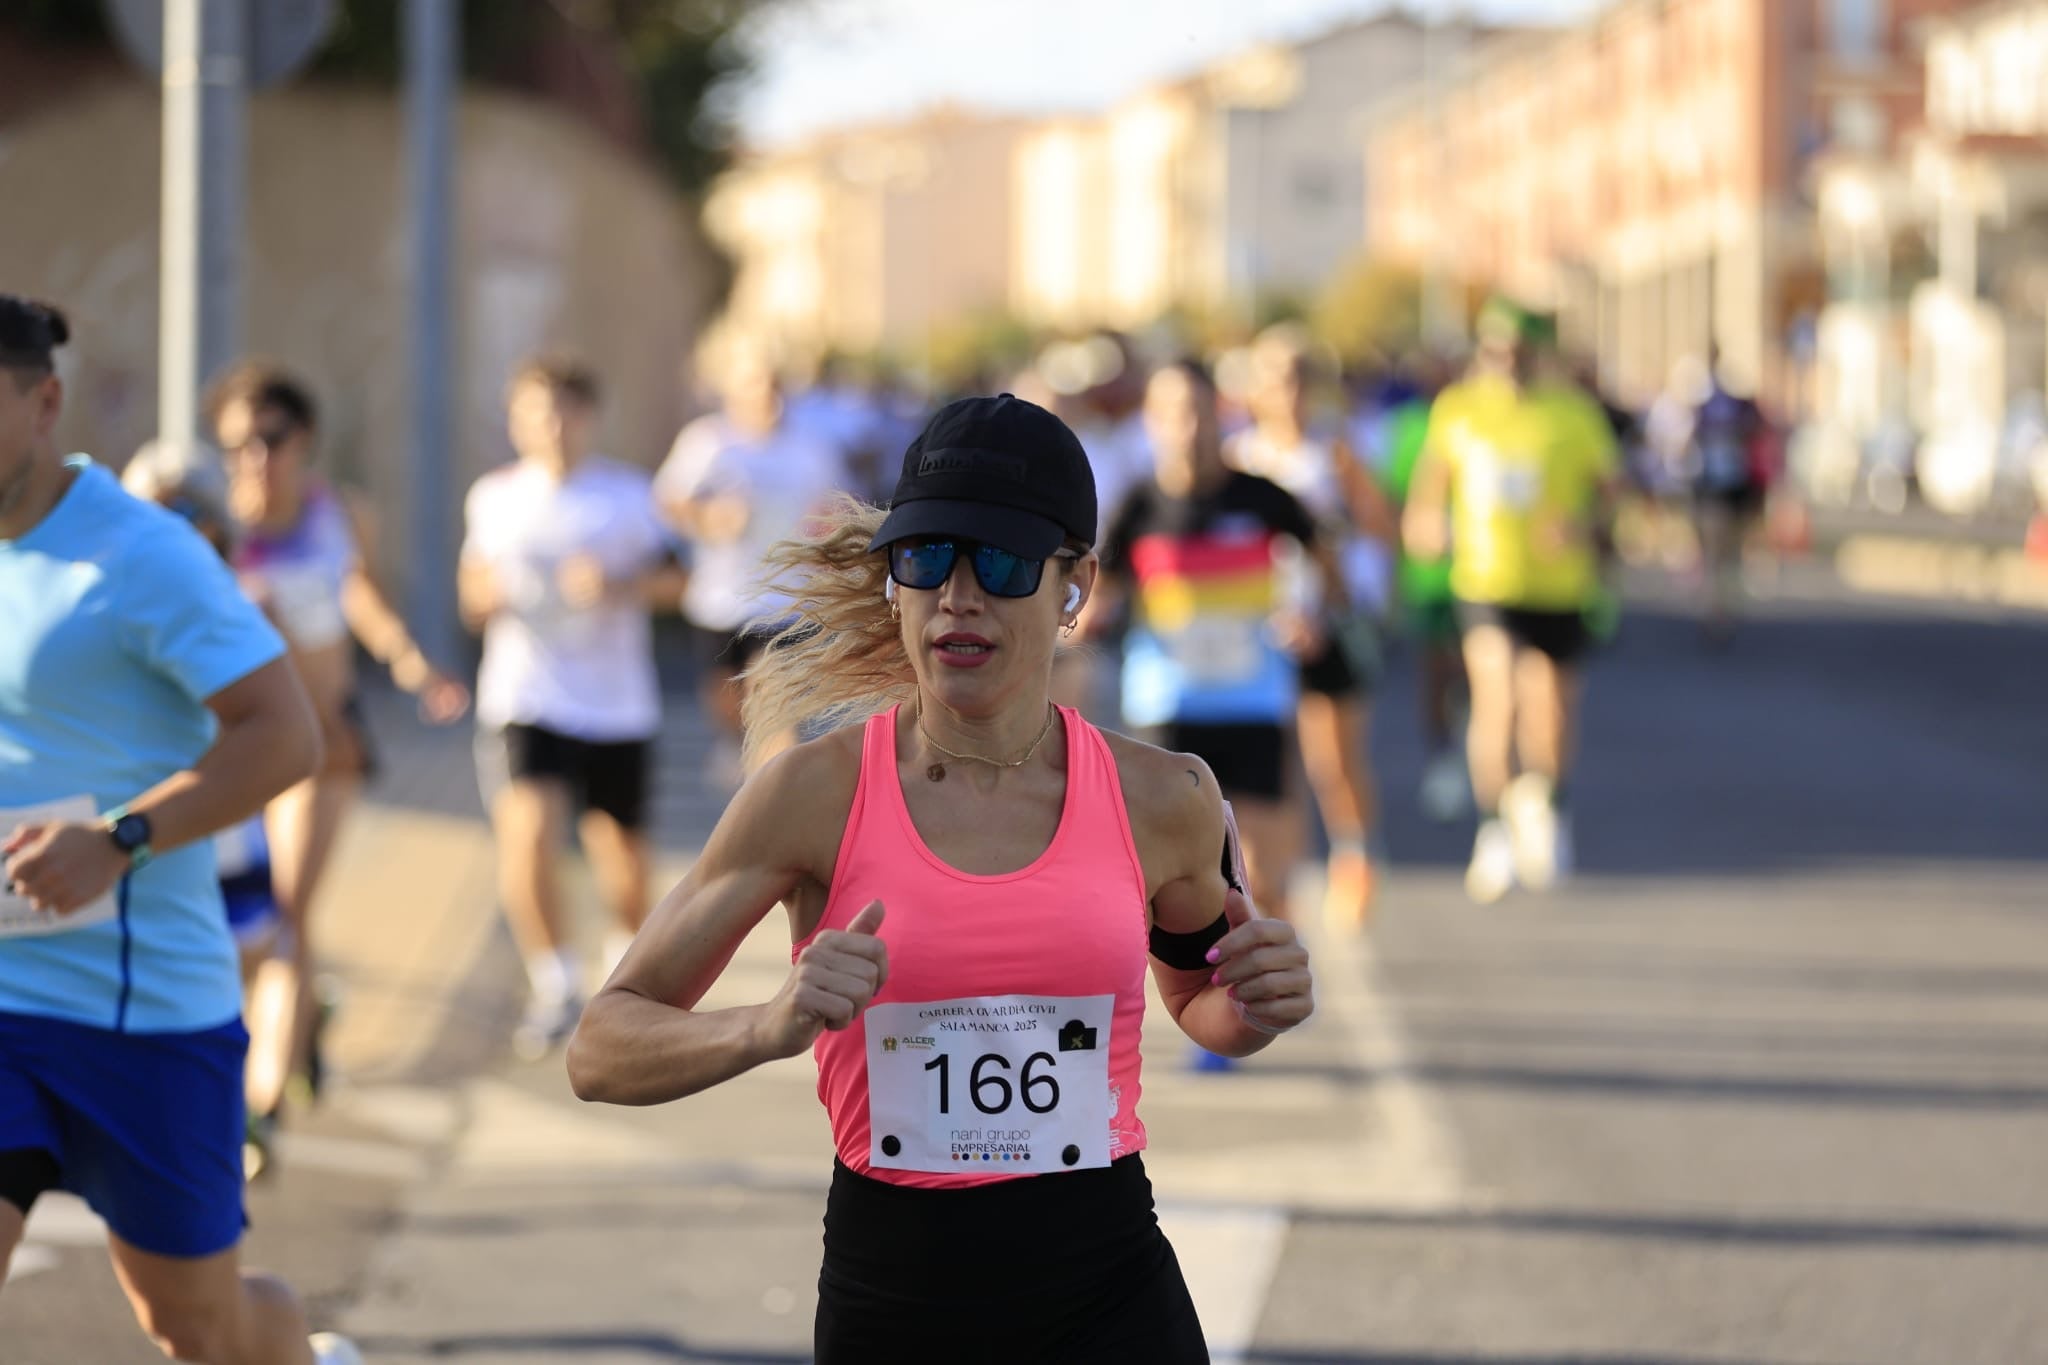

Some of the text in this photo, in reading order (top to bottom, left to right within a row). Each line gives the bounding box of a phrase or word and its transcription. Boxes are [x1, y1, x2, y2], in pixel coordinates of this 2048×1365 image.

[919, 1007, 974, 1019] CARRERA
[1028, 1004, 1056, 1015] CIVIL
[939, 1019, 1037, 1033] SALAMANCA 2025
[902, 1036, 936, 1047] ALCER
[924, 1051, 1060, 1115] 166
[951, 1127, 1031, 1144] nani grupo
[951, 1143, 1031, 1153] EMPRESARIAL
